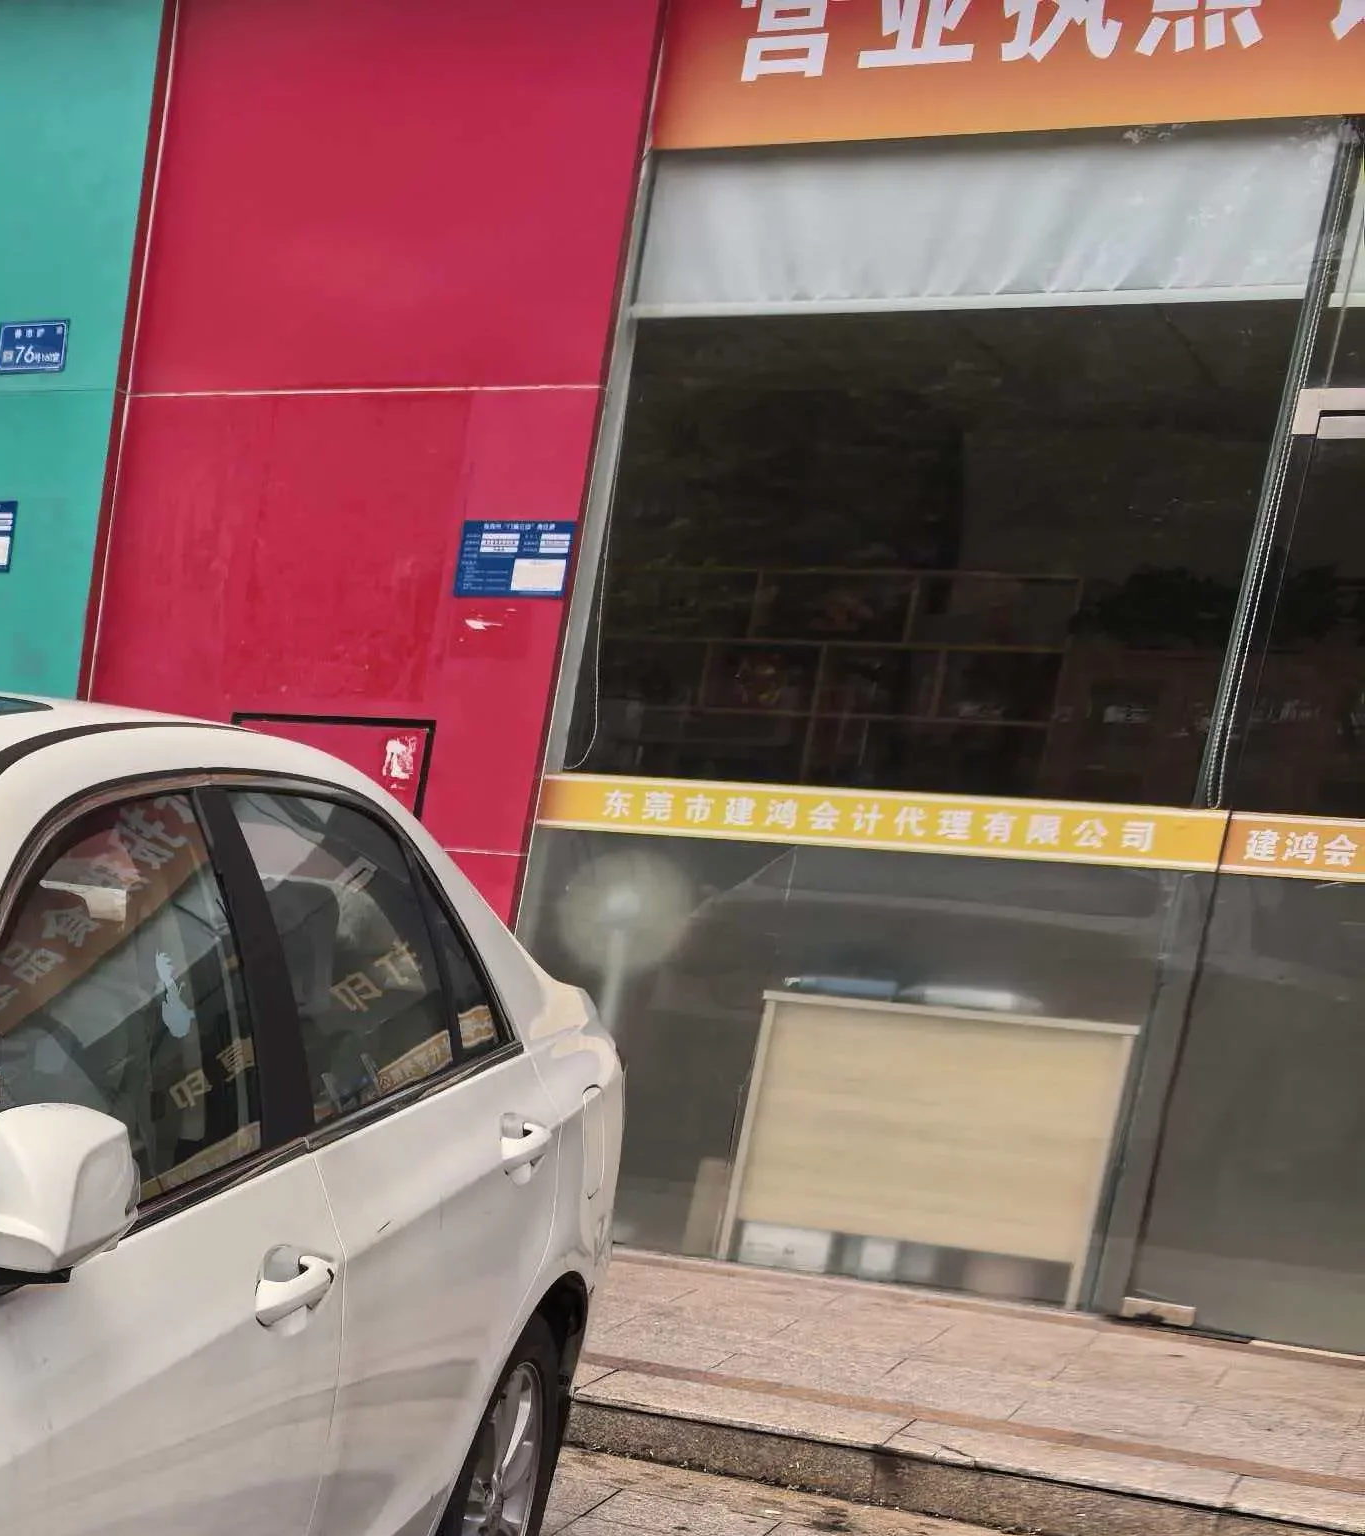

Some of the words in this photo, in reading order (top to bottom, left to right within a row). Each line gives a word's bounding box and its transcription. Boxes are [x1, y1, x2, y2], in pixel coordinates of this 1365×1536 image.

[601, 788, 1157, 854] 东莞市建鸿会计代理有限公司
[1243, 828, 1359, 868] 建鸿会
